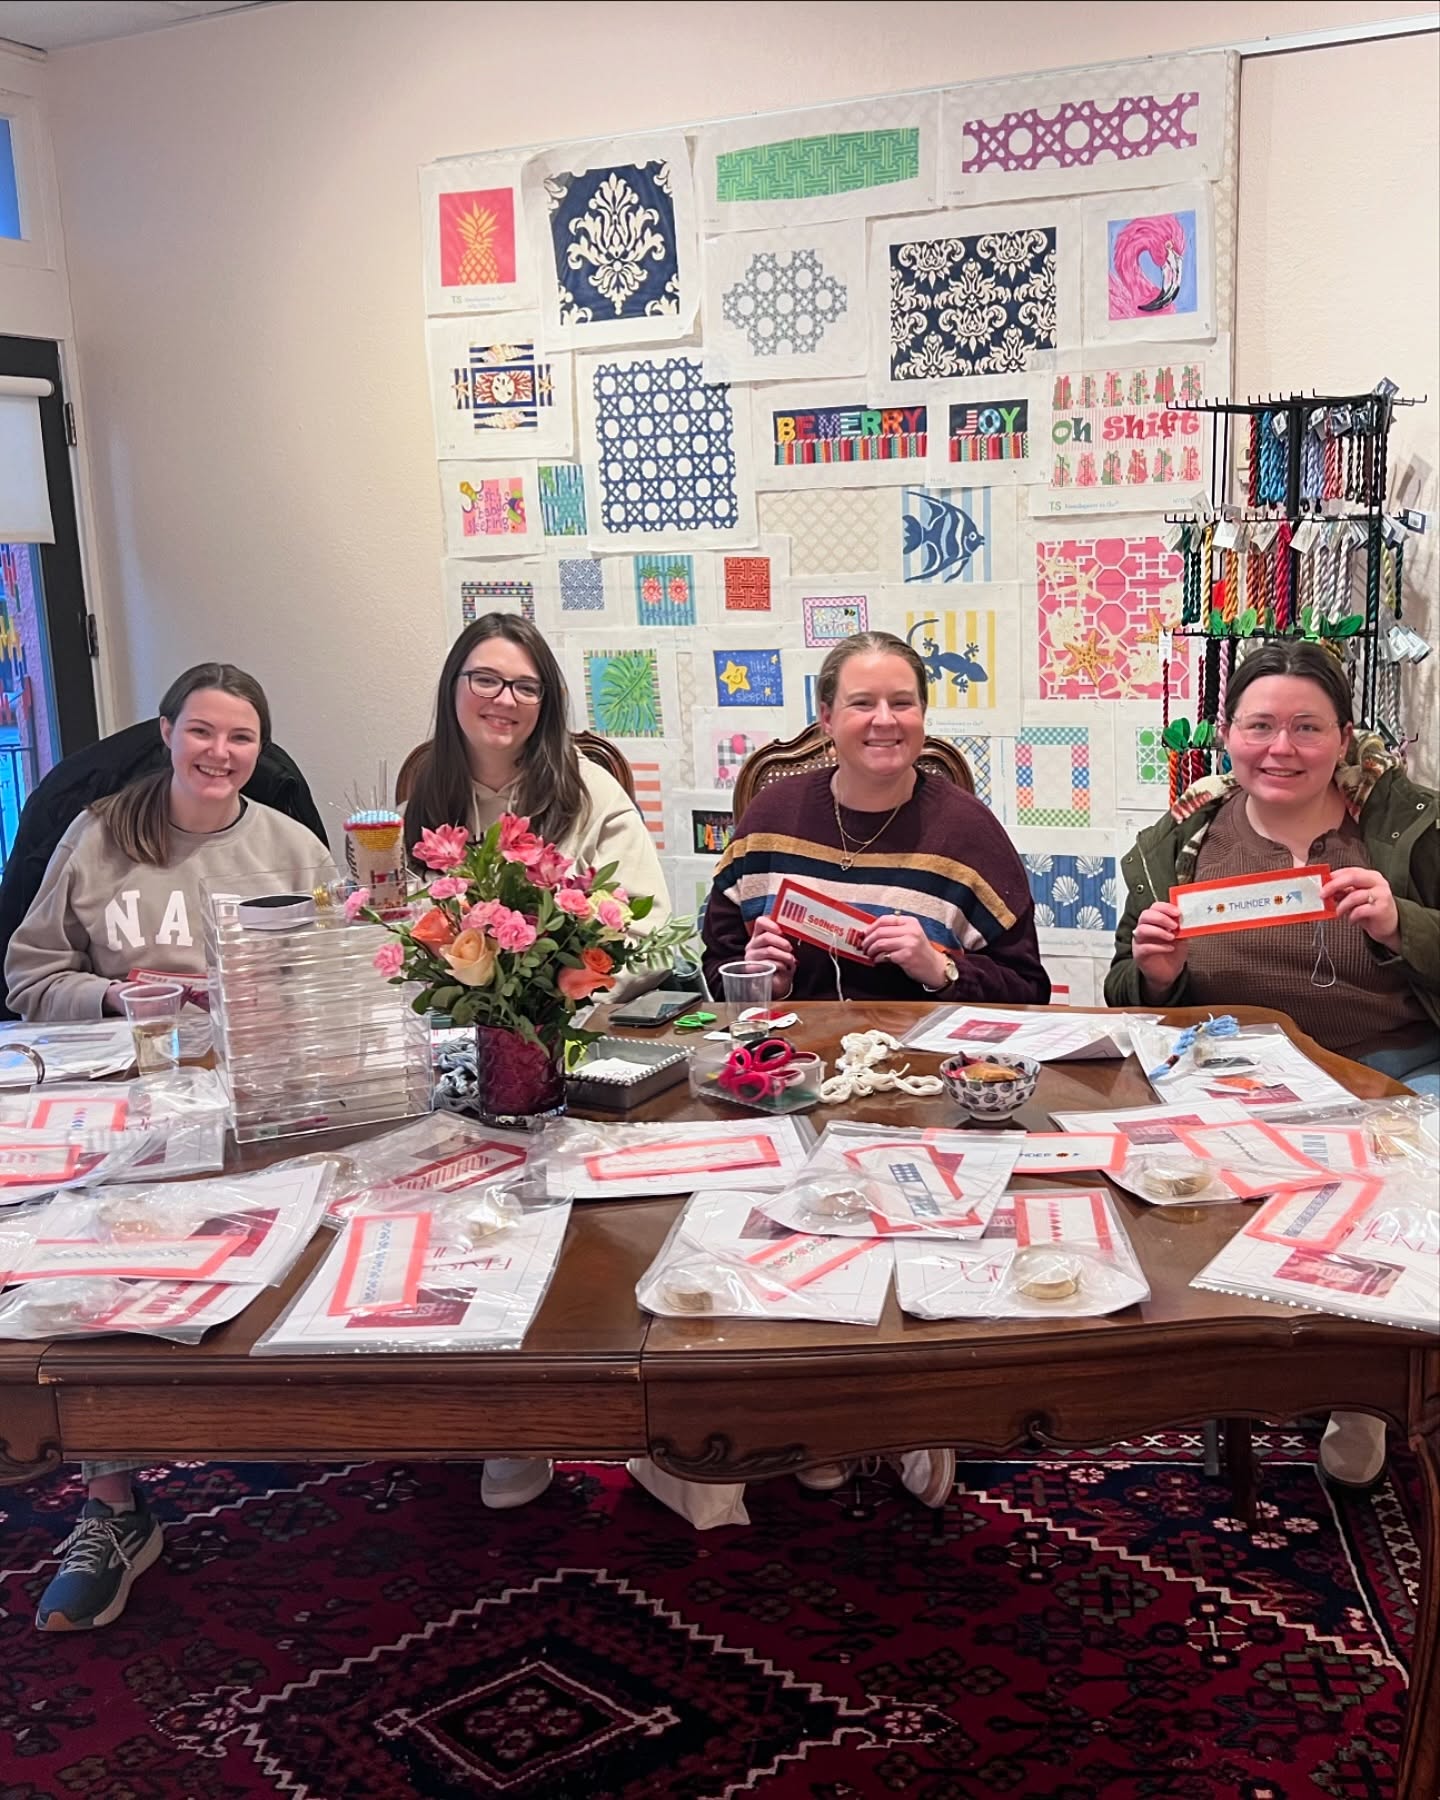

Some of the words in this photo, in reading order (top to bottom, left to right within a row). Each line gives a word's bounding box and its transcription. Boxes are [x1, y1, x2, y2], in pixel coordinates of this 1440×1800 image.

[777, 415, 816, 441] BE
[818, 406, 922, 436] MERRY
[956, 407, 1020, 434] JOY
[1050, 501, 1062, 511] TS
[1229, 897, 1271, 912] THUNDER
